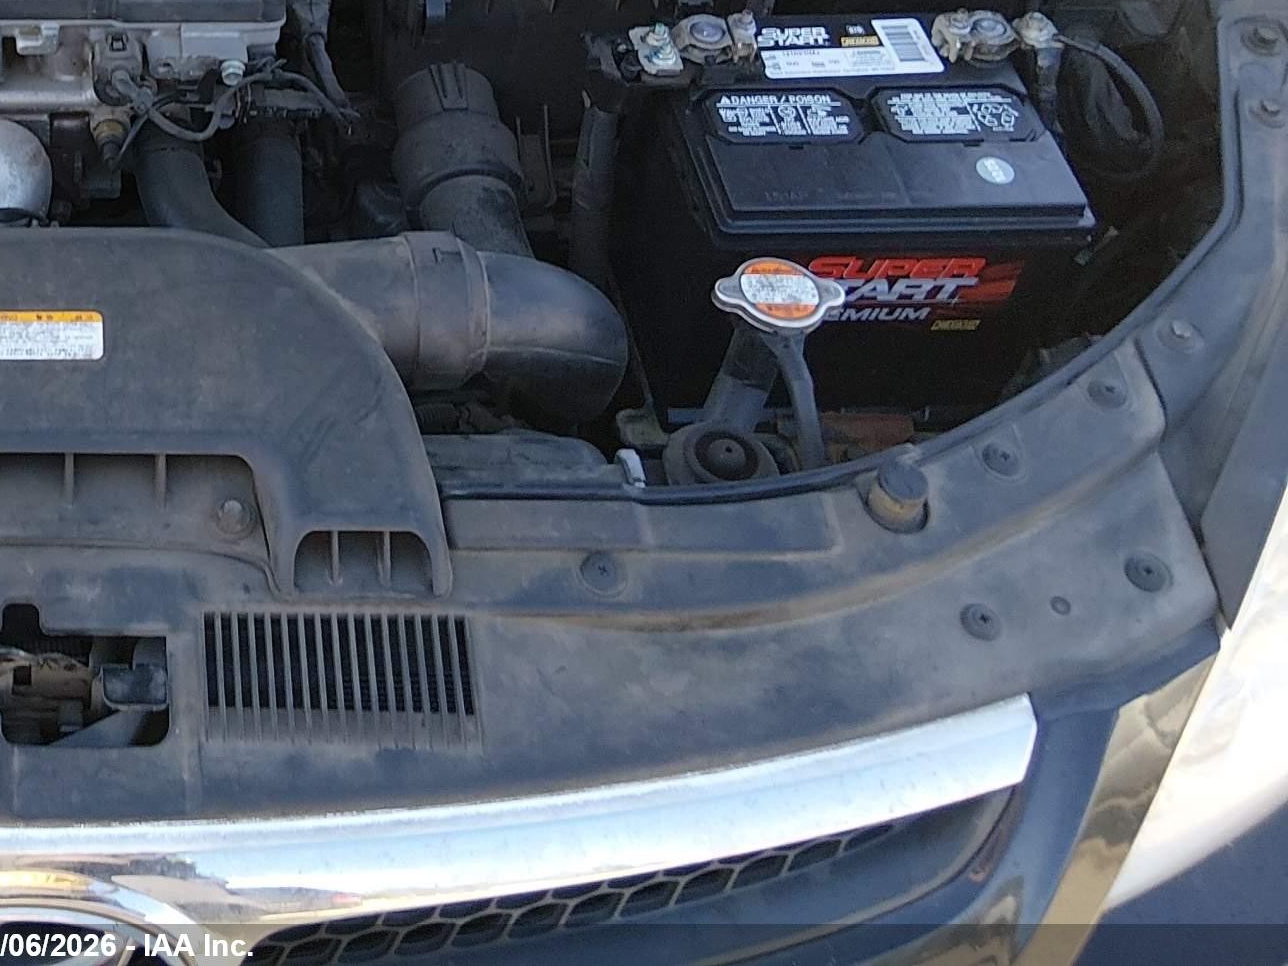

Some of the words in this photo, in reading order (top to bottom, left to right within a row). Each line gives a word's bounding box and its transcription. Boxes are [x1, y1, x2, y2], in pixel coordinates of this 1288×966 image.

[731, 94, 777, 105] DANGER
[788, 94, 831, 105] POISON
[808, 255, 986, 279] SUPER
[823, 306, 932, 322] EMIUM
